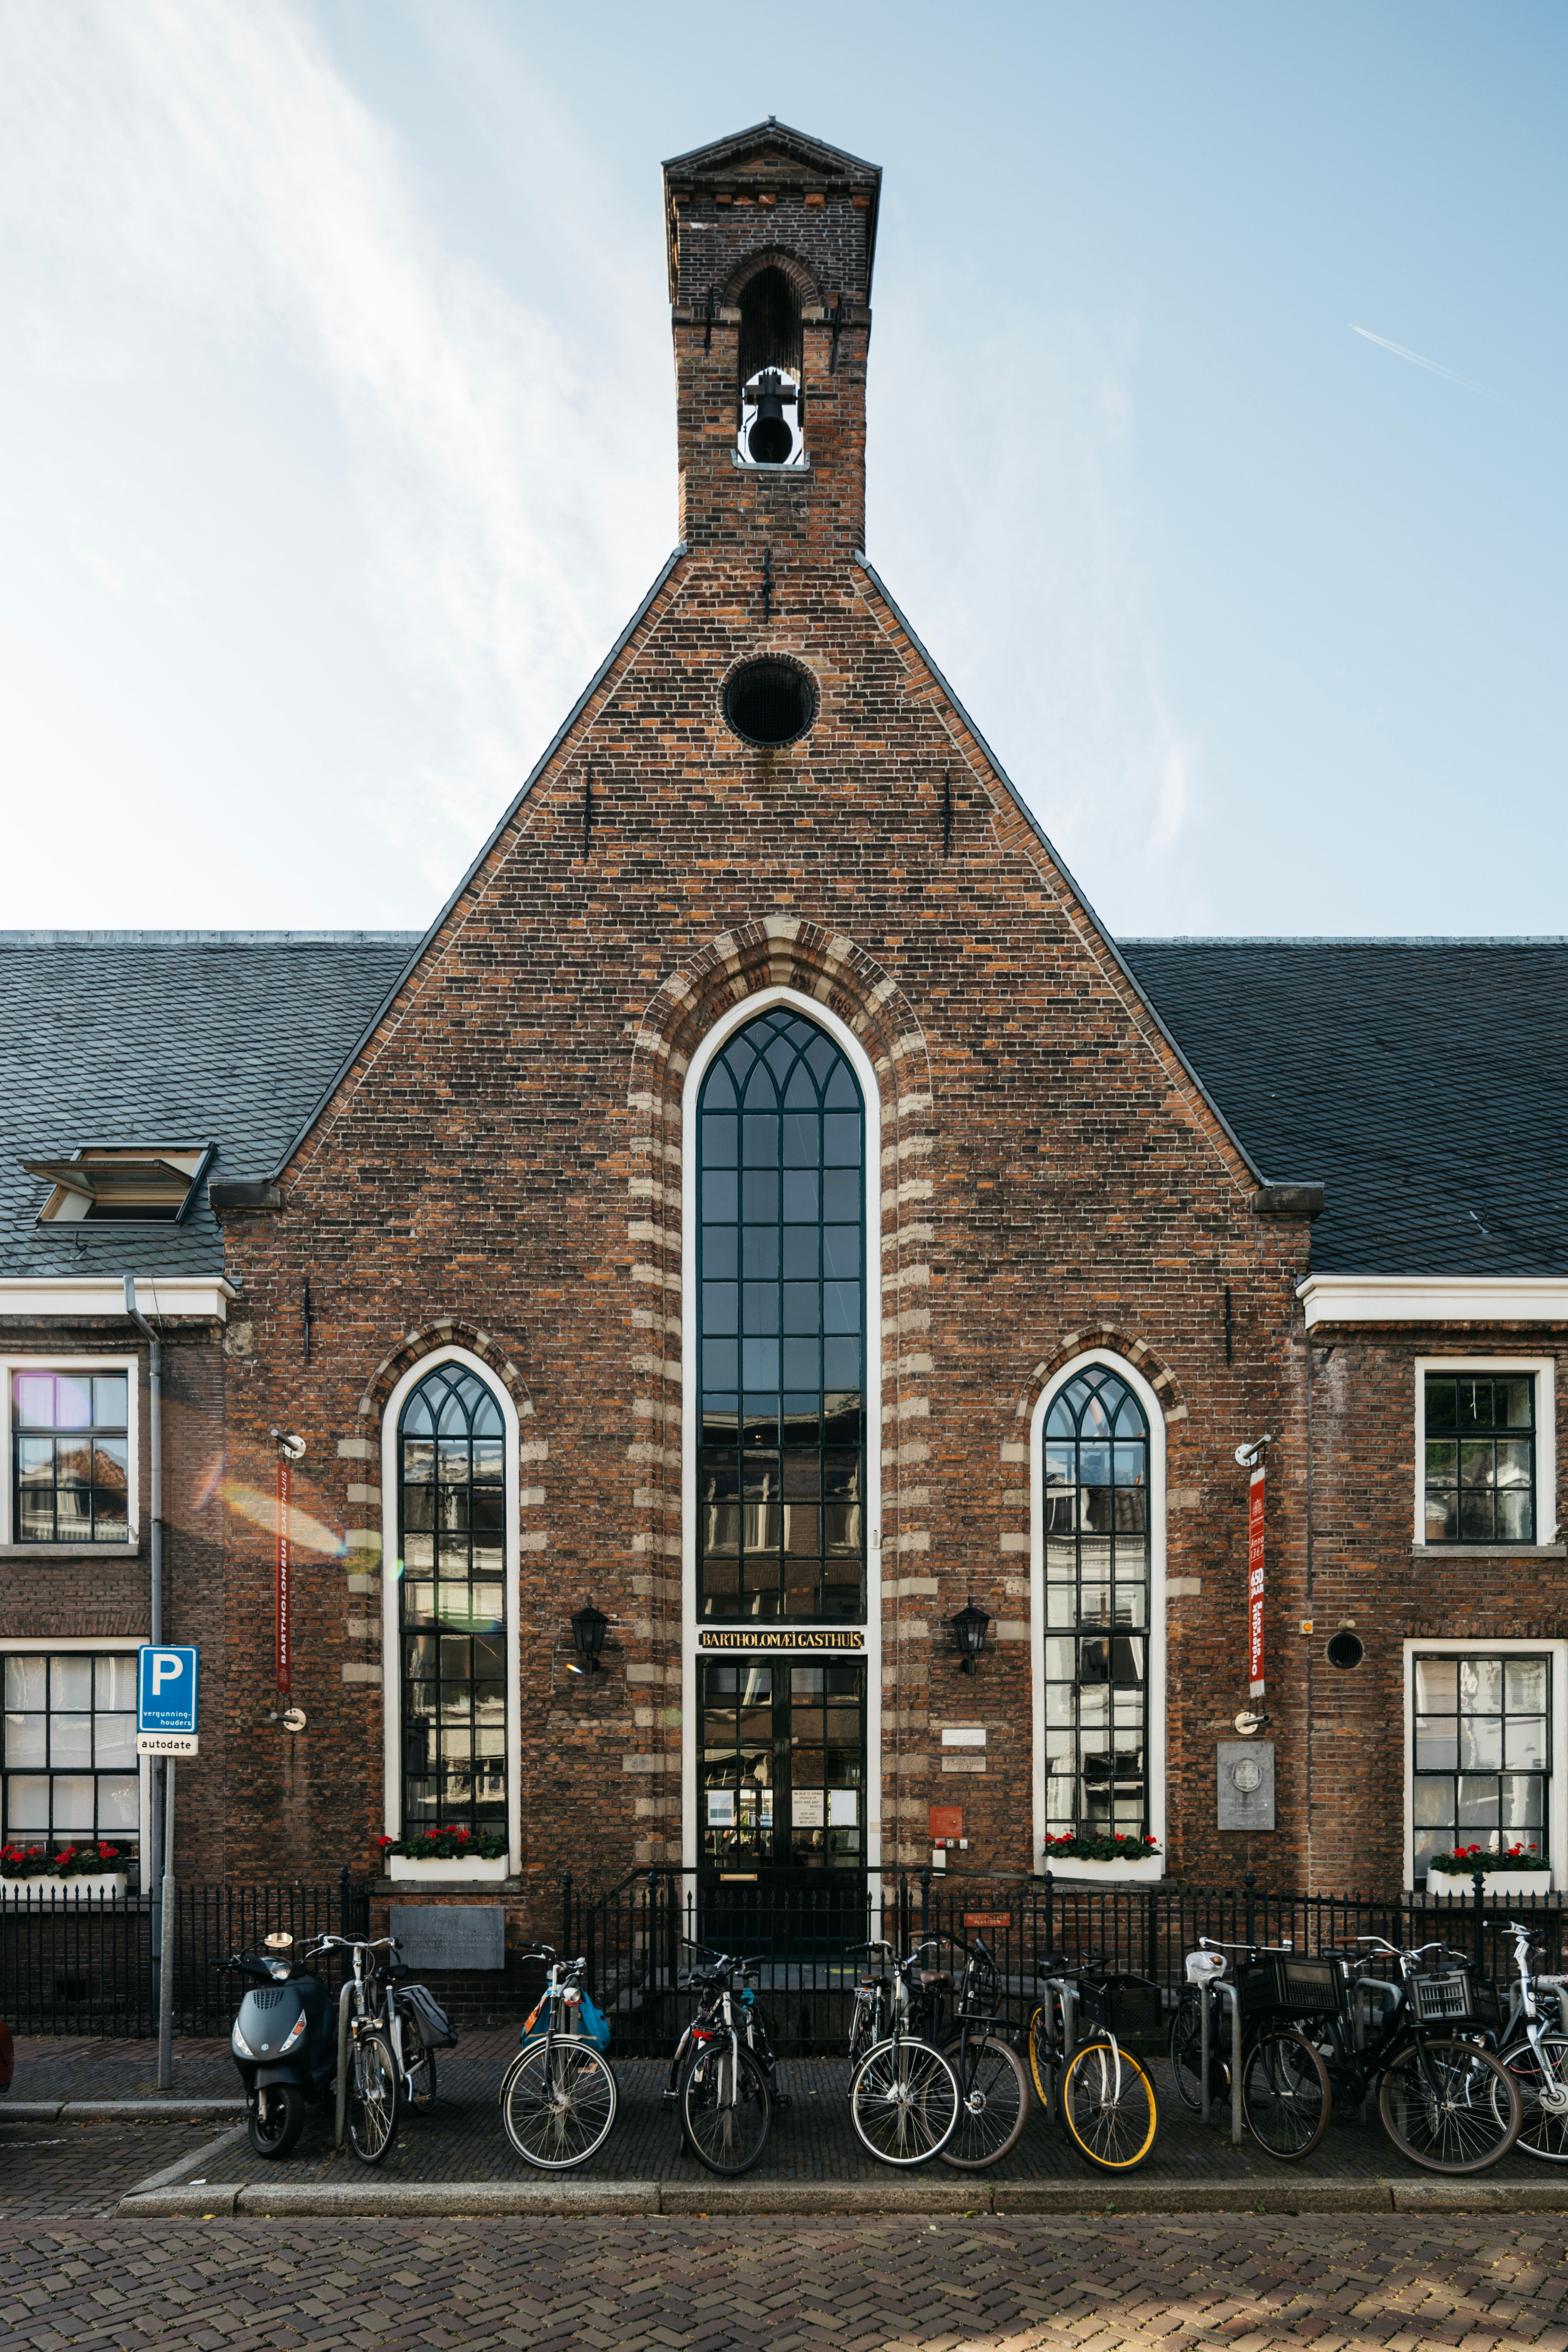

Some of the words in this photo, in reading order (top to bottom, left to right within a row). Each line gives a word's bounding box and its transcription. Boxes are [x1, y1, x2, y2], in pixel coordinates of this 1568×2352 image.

[1250, 1536, 1264, 1549] Anno
[1250, 1544, 1264, 1559] 1367
[1250, 1567, 1264, 1587] 650
[1250, 1583, 1264, 1599] JAAR
[1257, 1638, 1261, 1656] en
[153, 1654, 183, 1695] P
[142, 1740, 191, 1749] autodate
